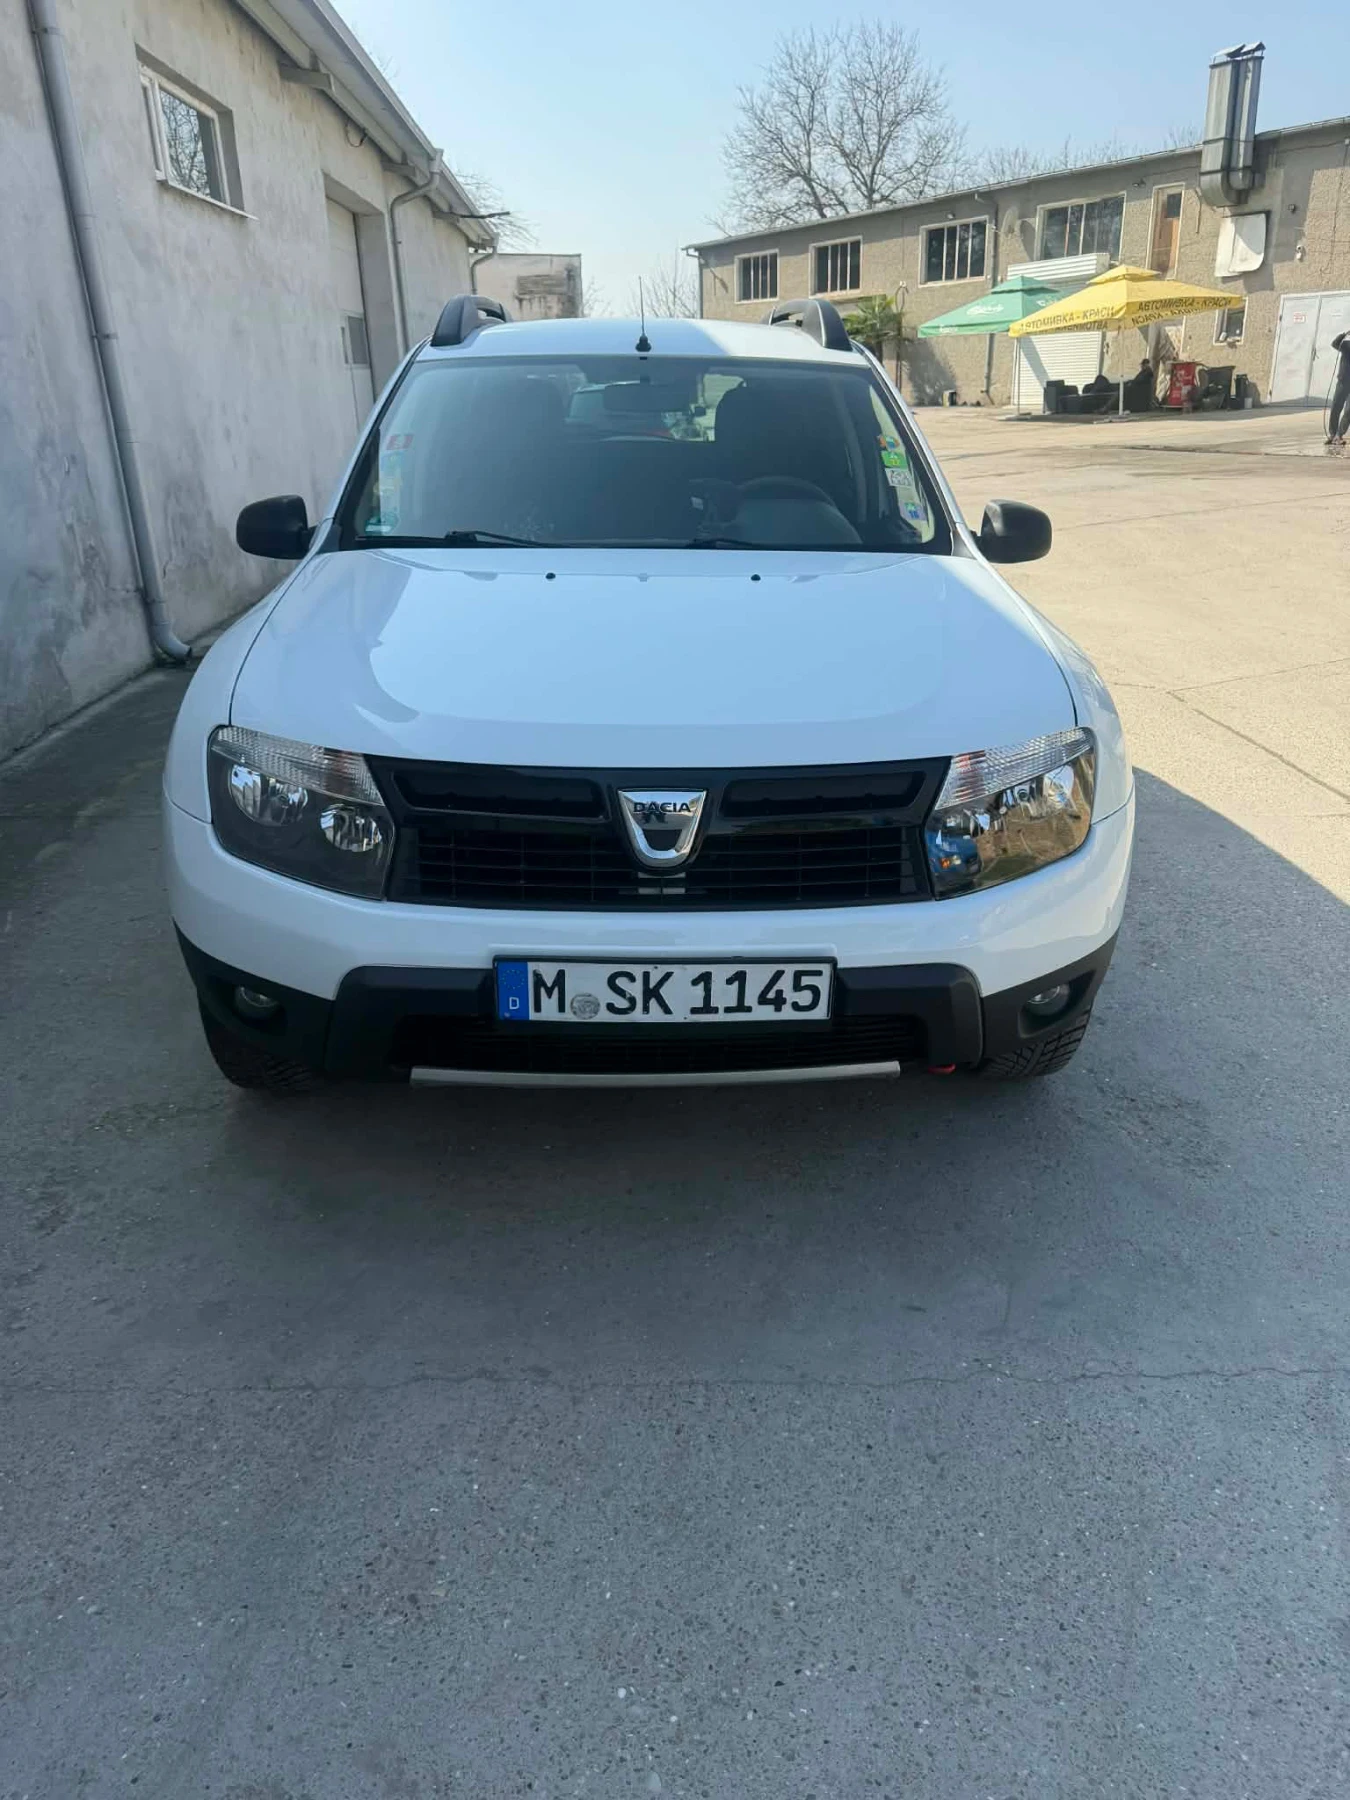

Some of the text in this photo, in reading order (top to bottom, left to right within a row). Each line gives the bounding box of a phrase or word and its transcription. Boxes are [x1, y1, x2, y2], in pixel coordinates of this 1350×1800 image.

[633, 802, 692, 813] DACIA
[533, 969, 823, 1015] M SK 1145
[509, 996, 520, 1010] D
